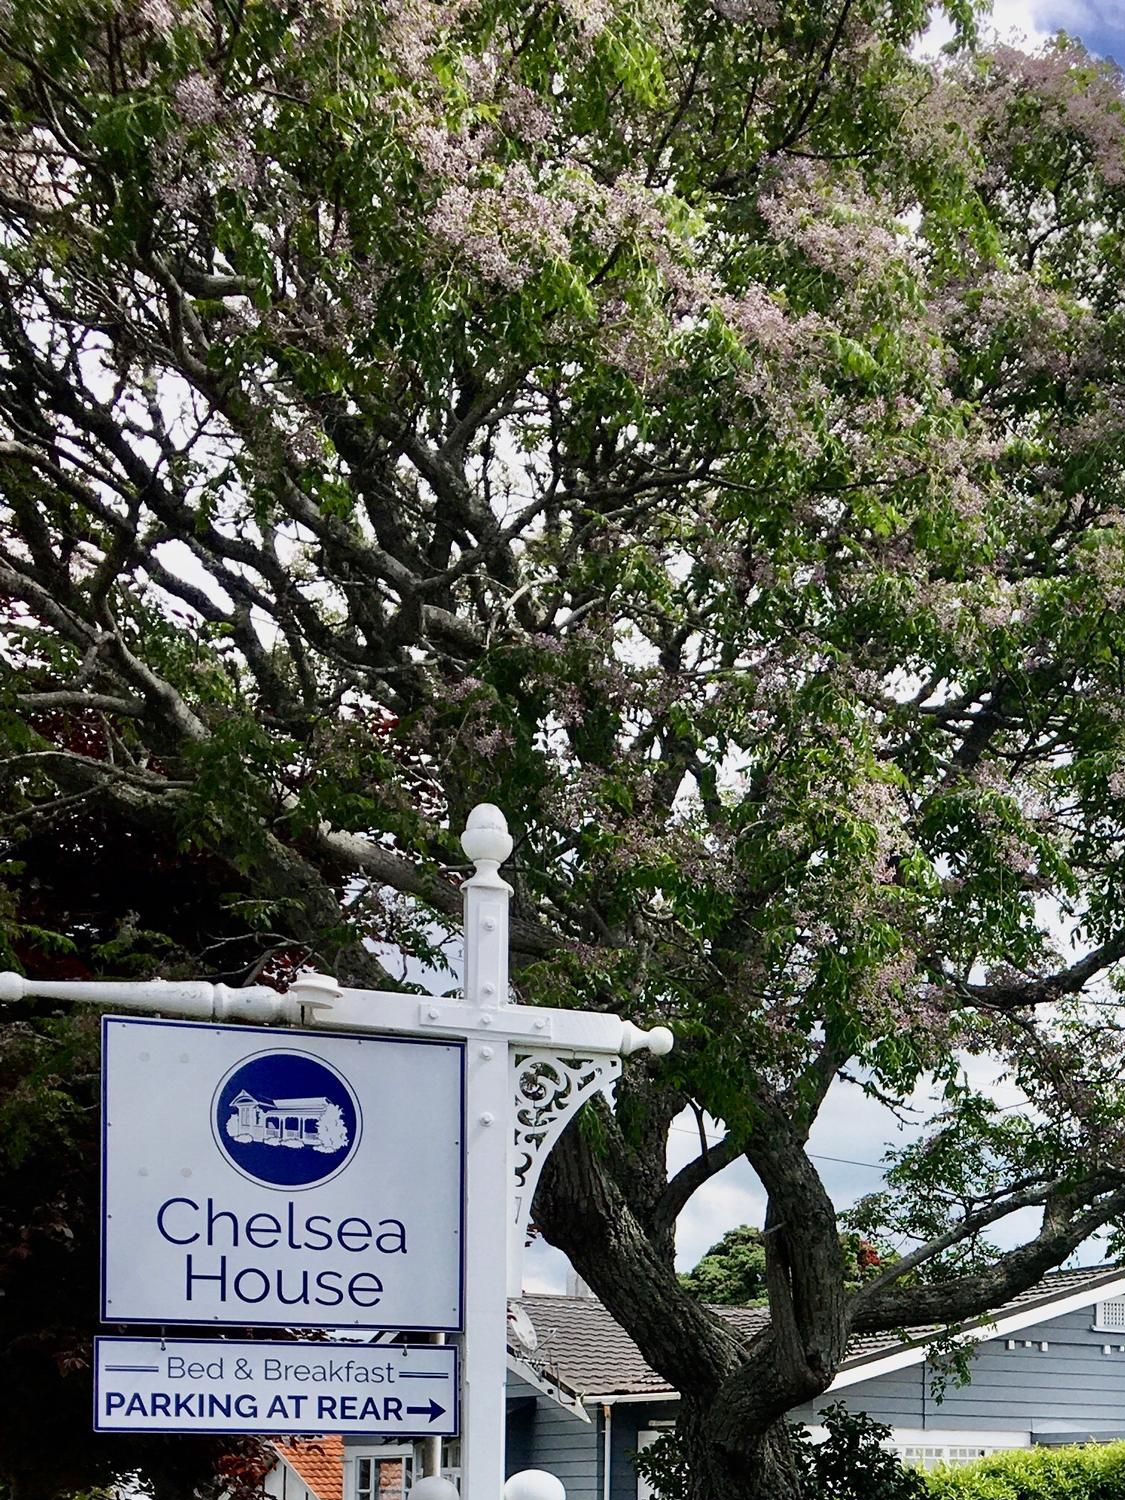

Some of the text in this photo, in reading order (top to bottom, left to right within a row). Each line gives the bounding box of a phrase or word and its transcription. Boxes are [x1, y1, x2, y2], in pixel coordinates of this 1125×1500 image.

[157, 1197, 407, 1254] Chelsea
[186, 1254, 384, 1307] House
[167, 1357, 395, 1383] Bed & Breakfast
[105, 1392, 403, 1421] PARKING AT REAR
